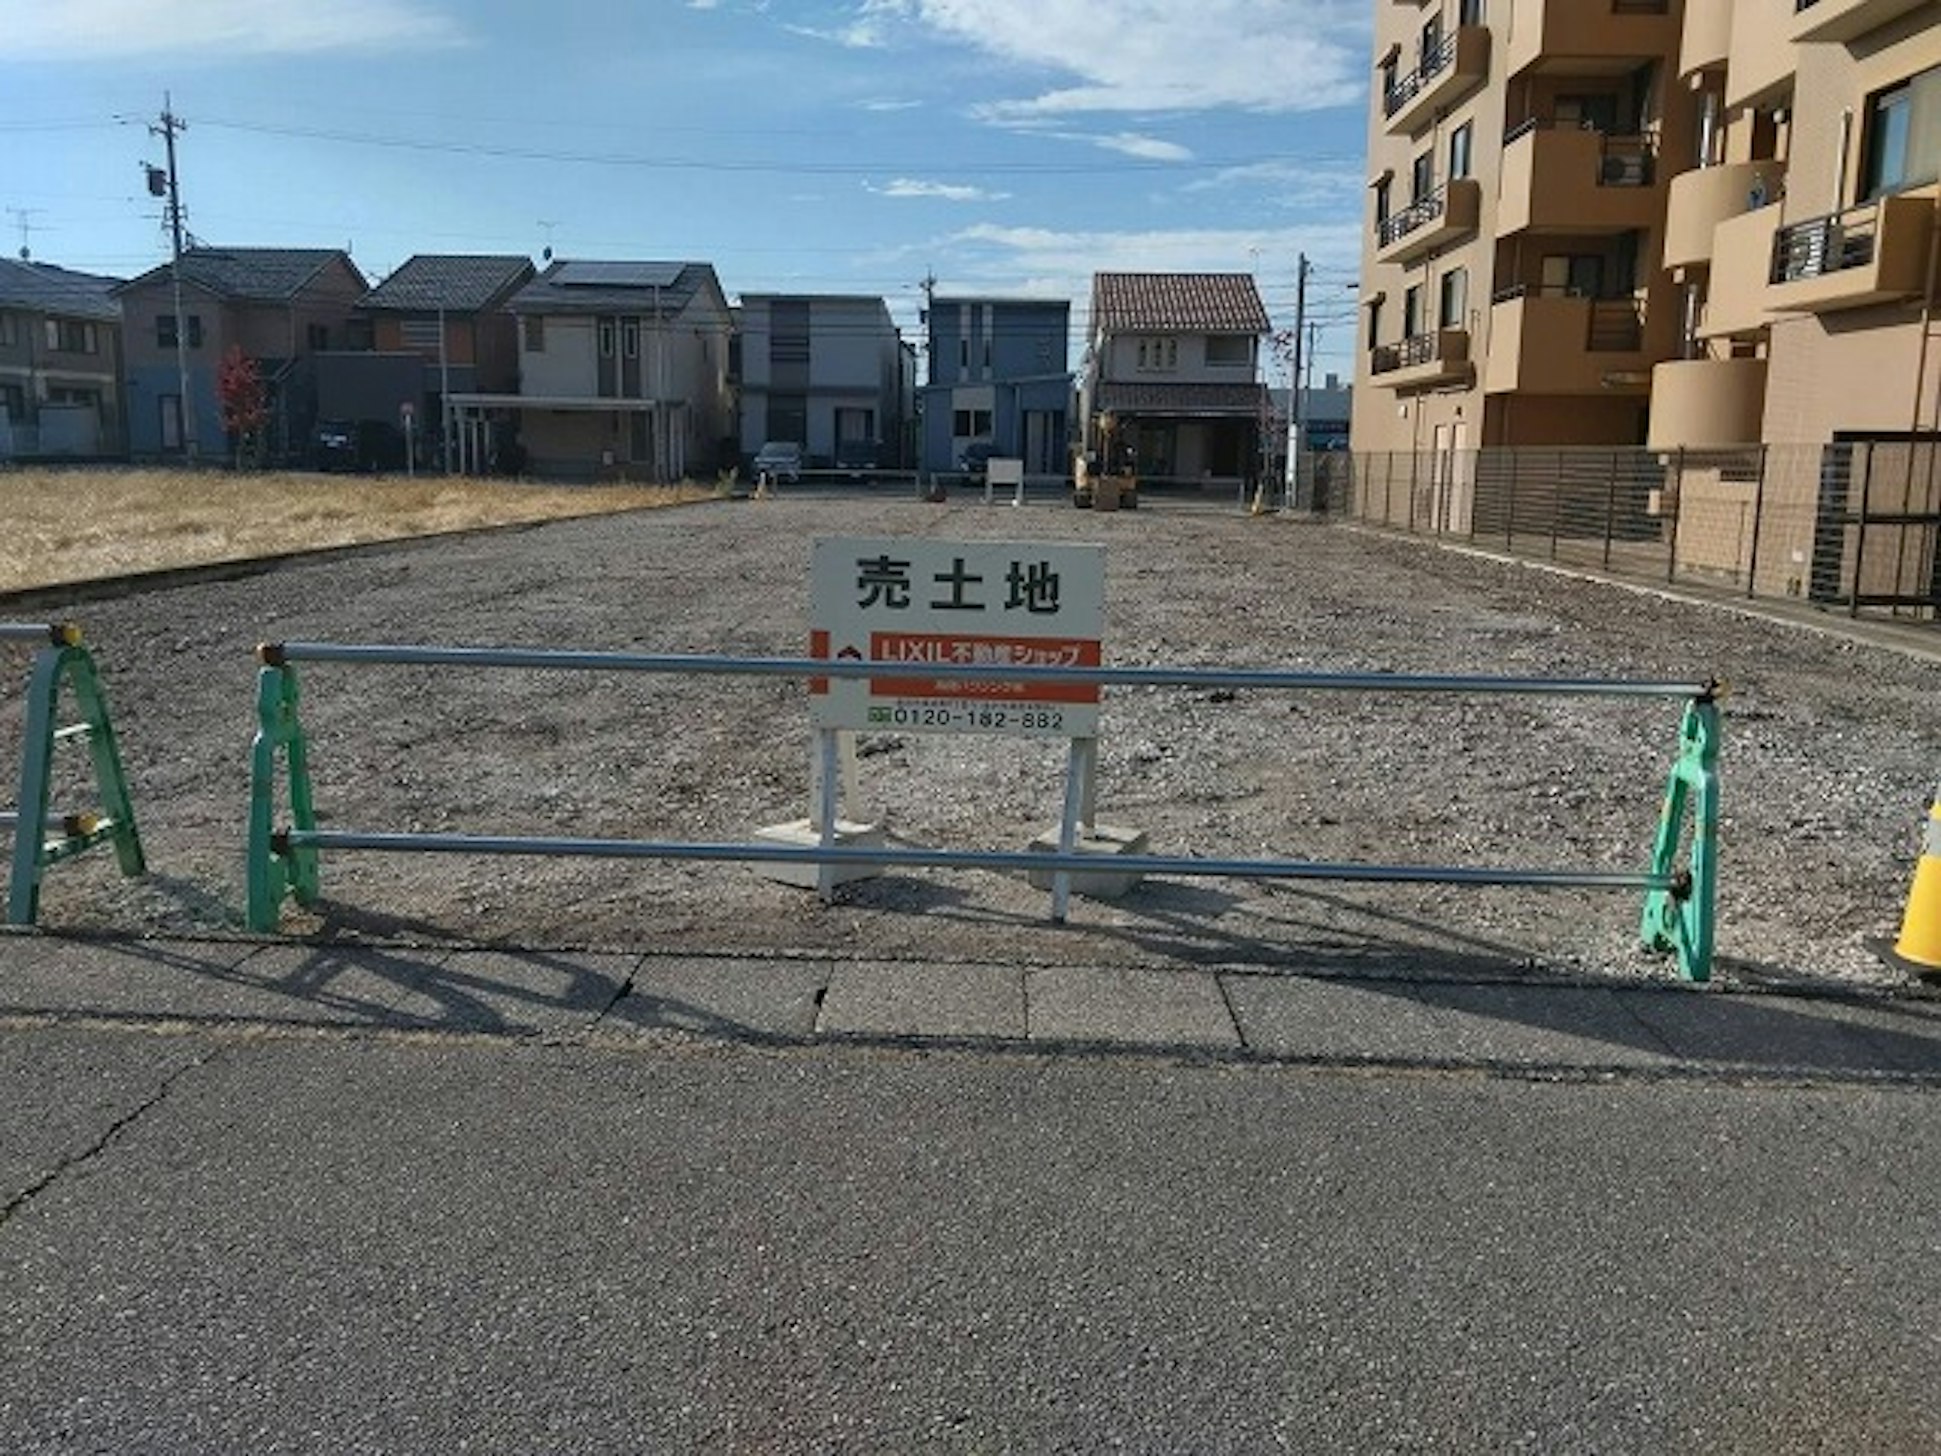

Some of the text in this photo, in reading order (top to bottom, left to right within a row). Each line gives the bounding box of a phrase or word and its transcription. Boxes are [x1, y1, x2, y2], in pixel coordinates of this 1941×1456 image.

[856, 554, 1061, 614] 売土地
[893, 708, 1064, 730] 0120-182-882
